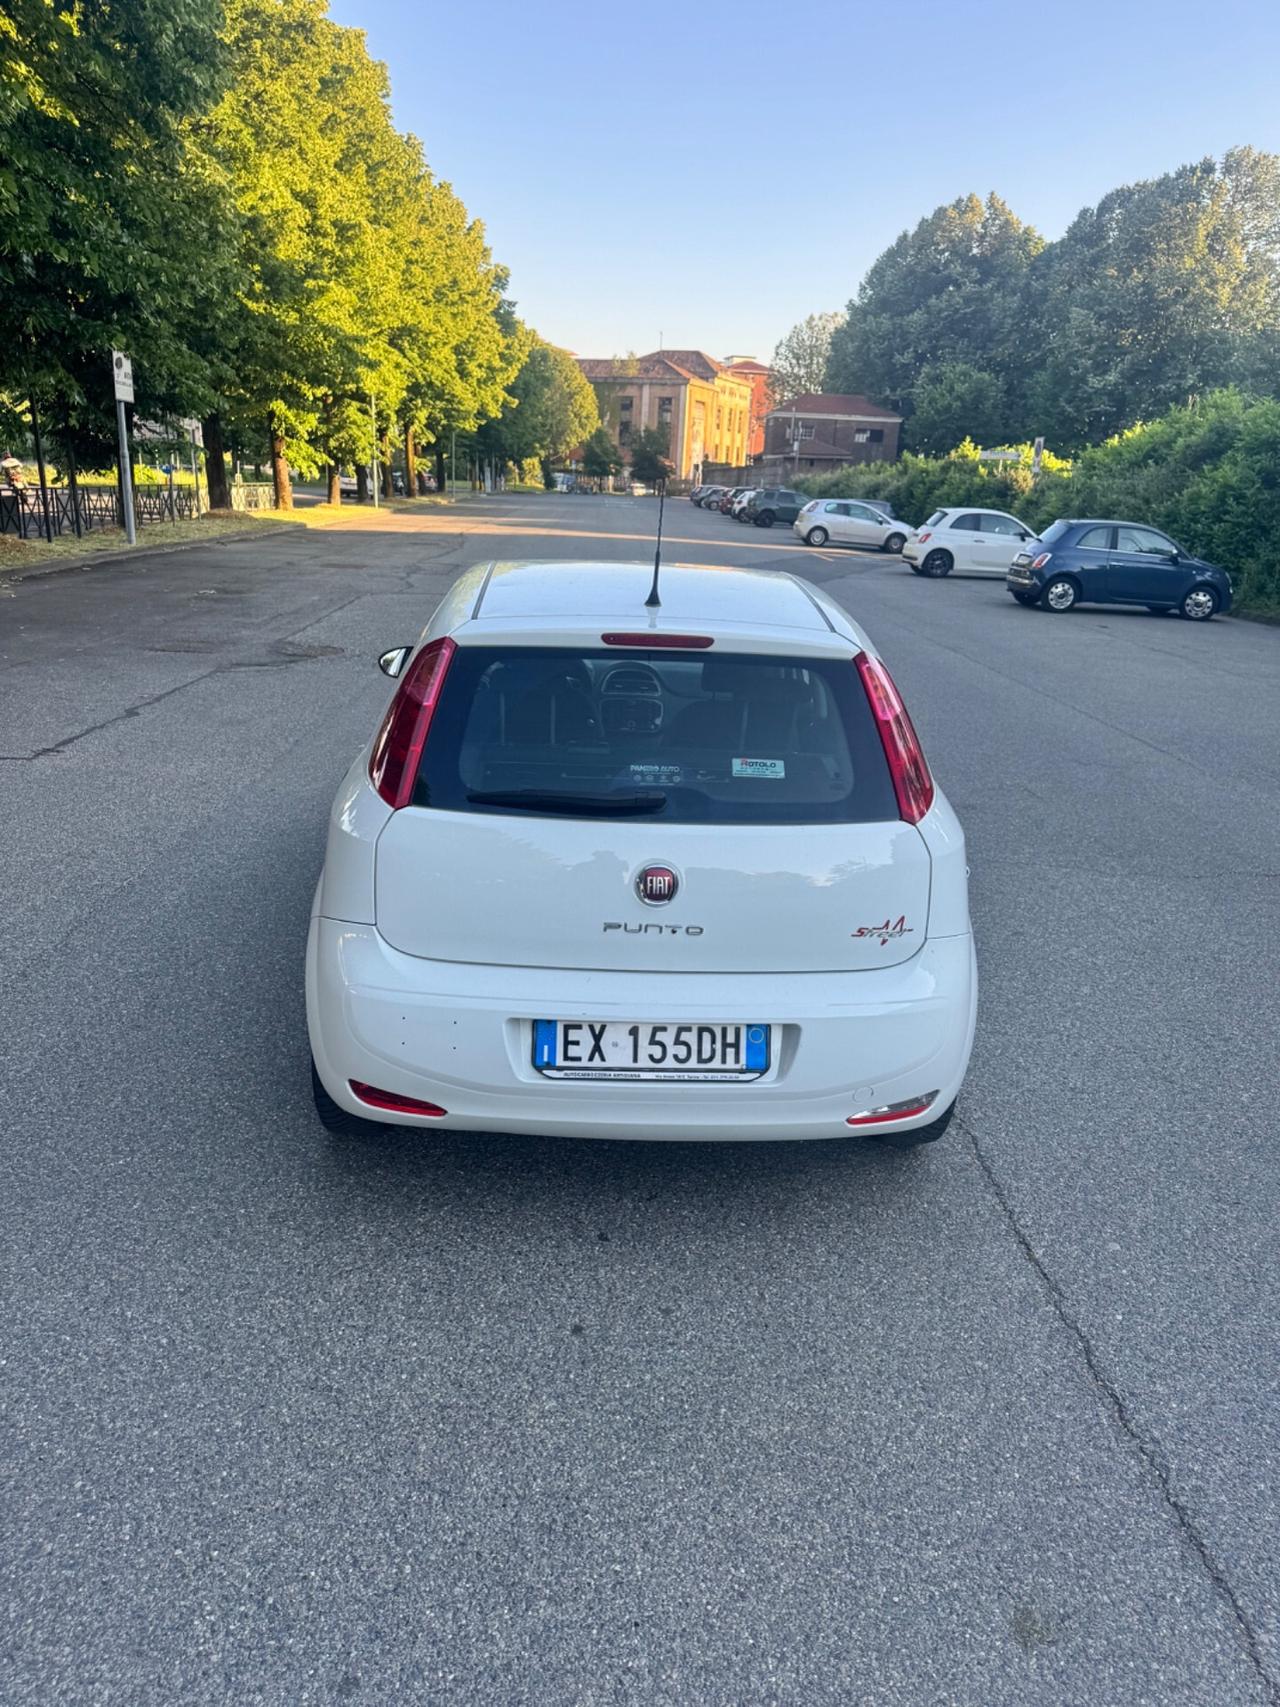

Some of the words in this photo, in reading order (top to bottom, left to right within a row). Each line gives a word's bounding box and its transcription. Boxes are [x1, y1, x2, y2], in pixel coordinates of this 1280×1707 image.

[646, 876, 671, 895] FIAT
[602, 921, 705, 937] PUNTO
[562, 1023, 607, 1062] EX
[628, 1025, 741, 1065] 155DH
